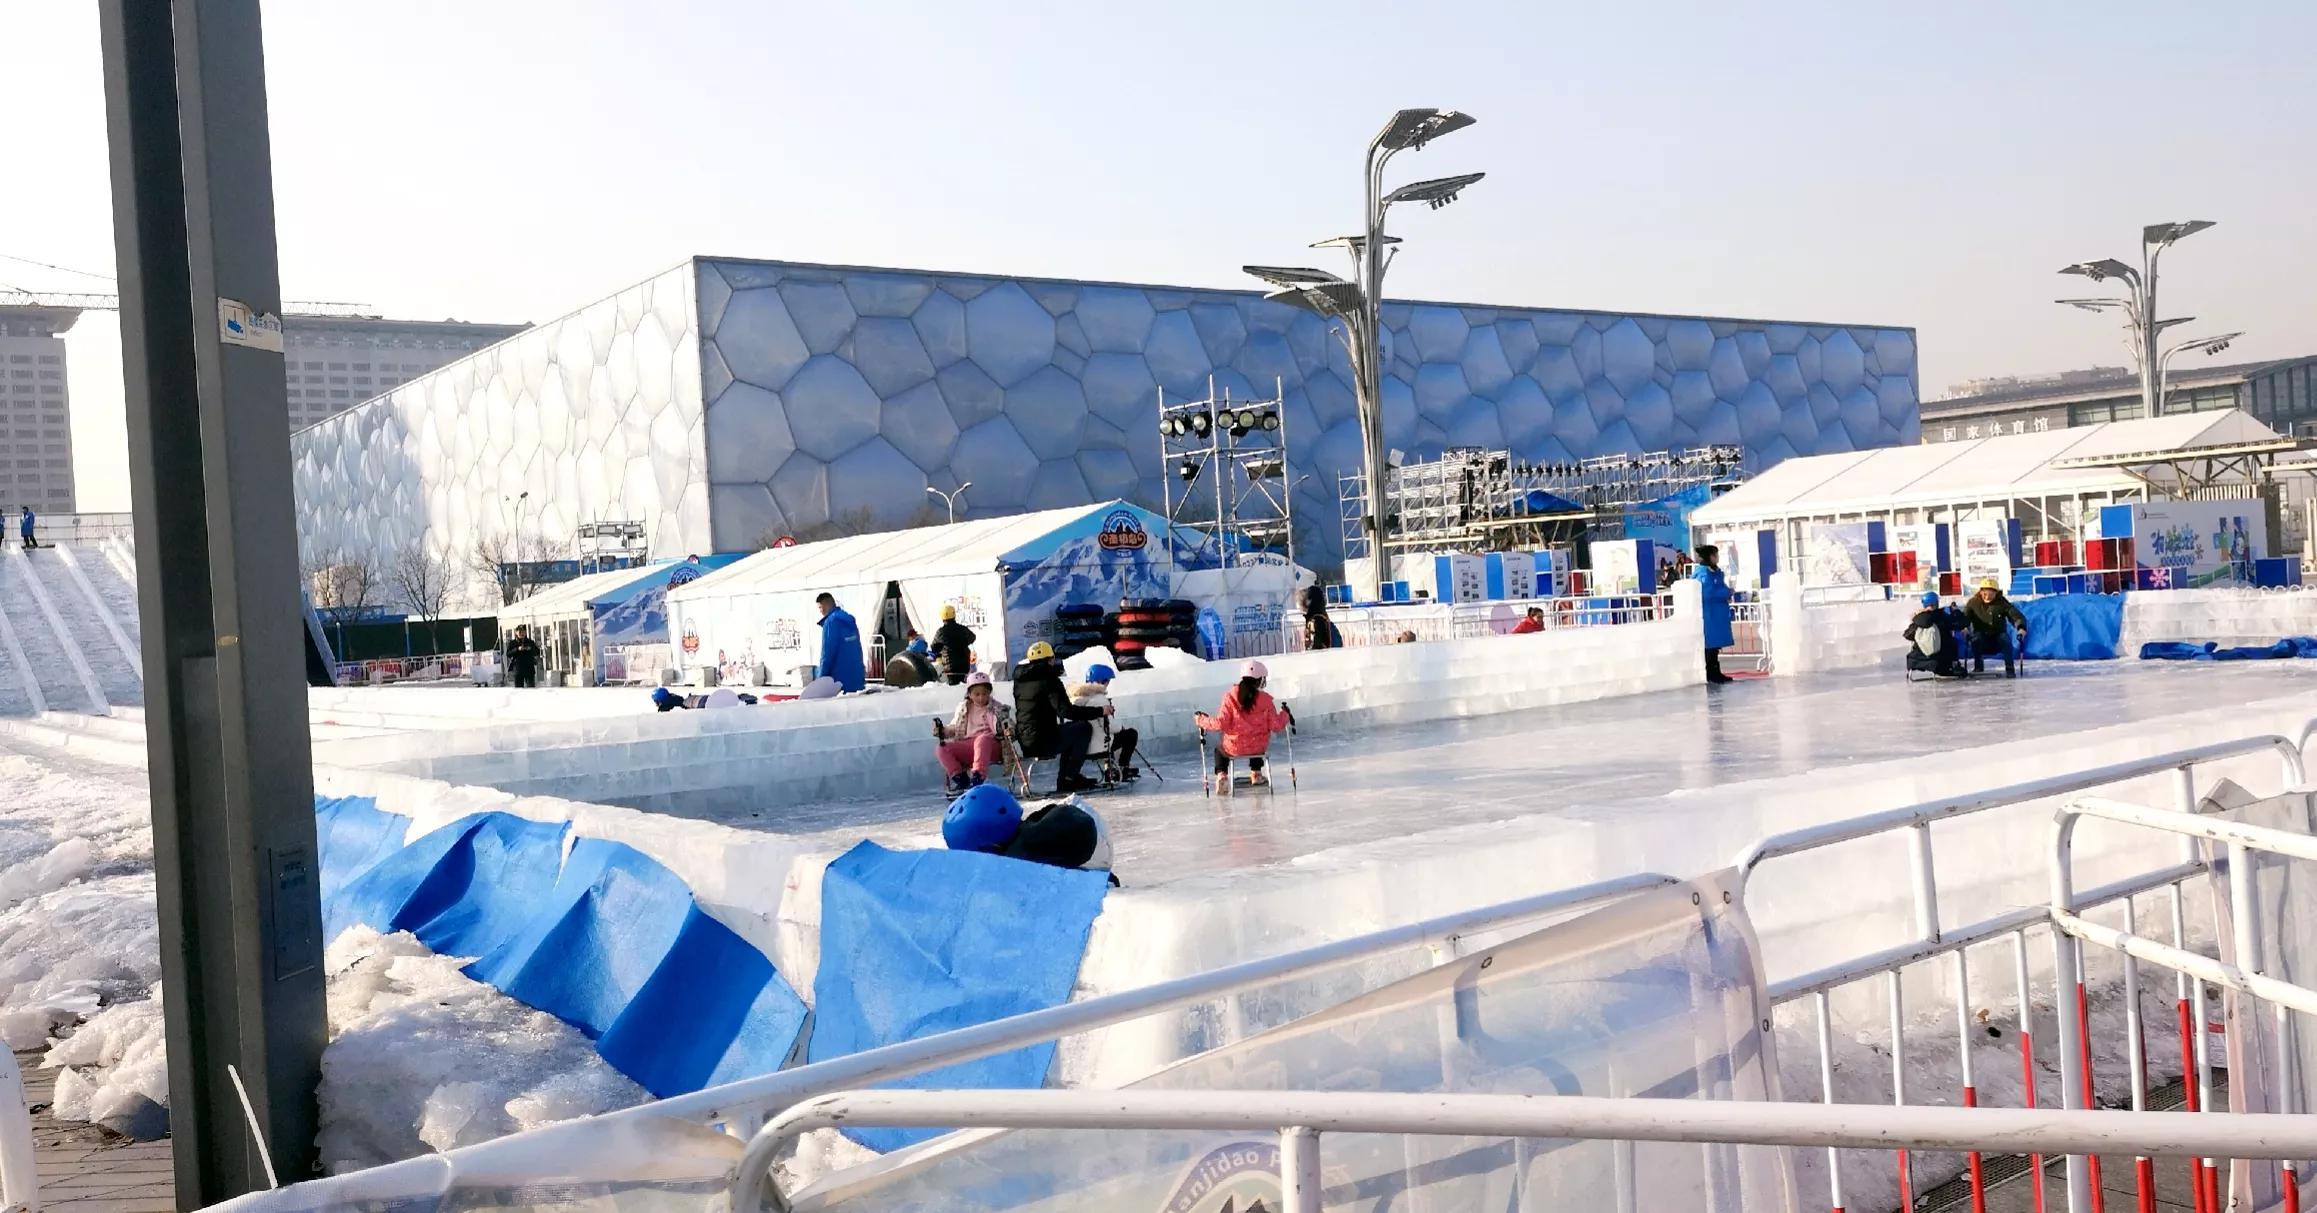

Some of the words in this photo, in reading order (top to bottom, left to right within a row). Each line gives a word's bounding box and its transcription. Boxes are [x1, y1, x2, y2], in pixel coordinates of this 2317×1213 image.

[1944, 417, 2048, 441] 国家体育馆
[1166, 1151, 1259, 1213] anjidao
